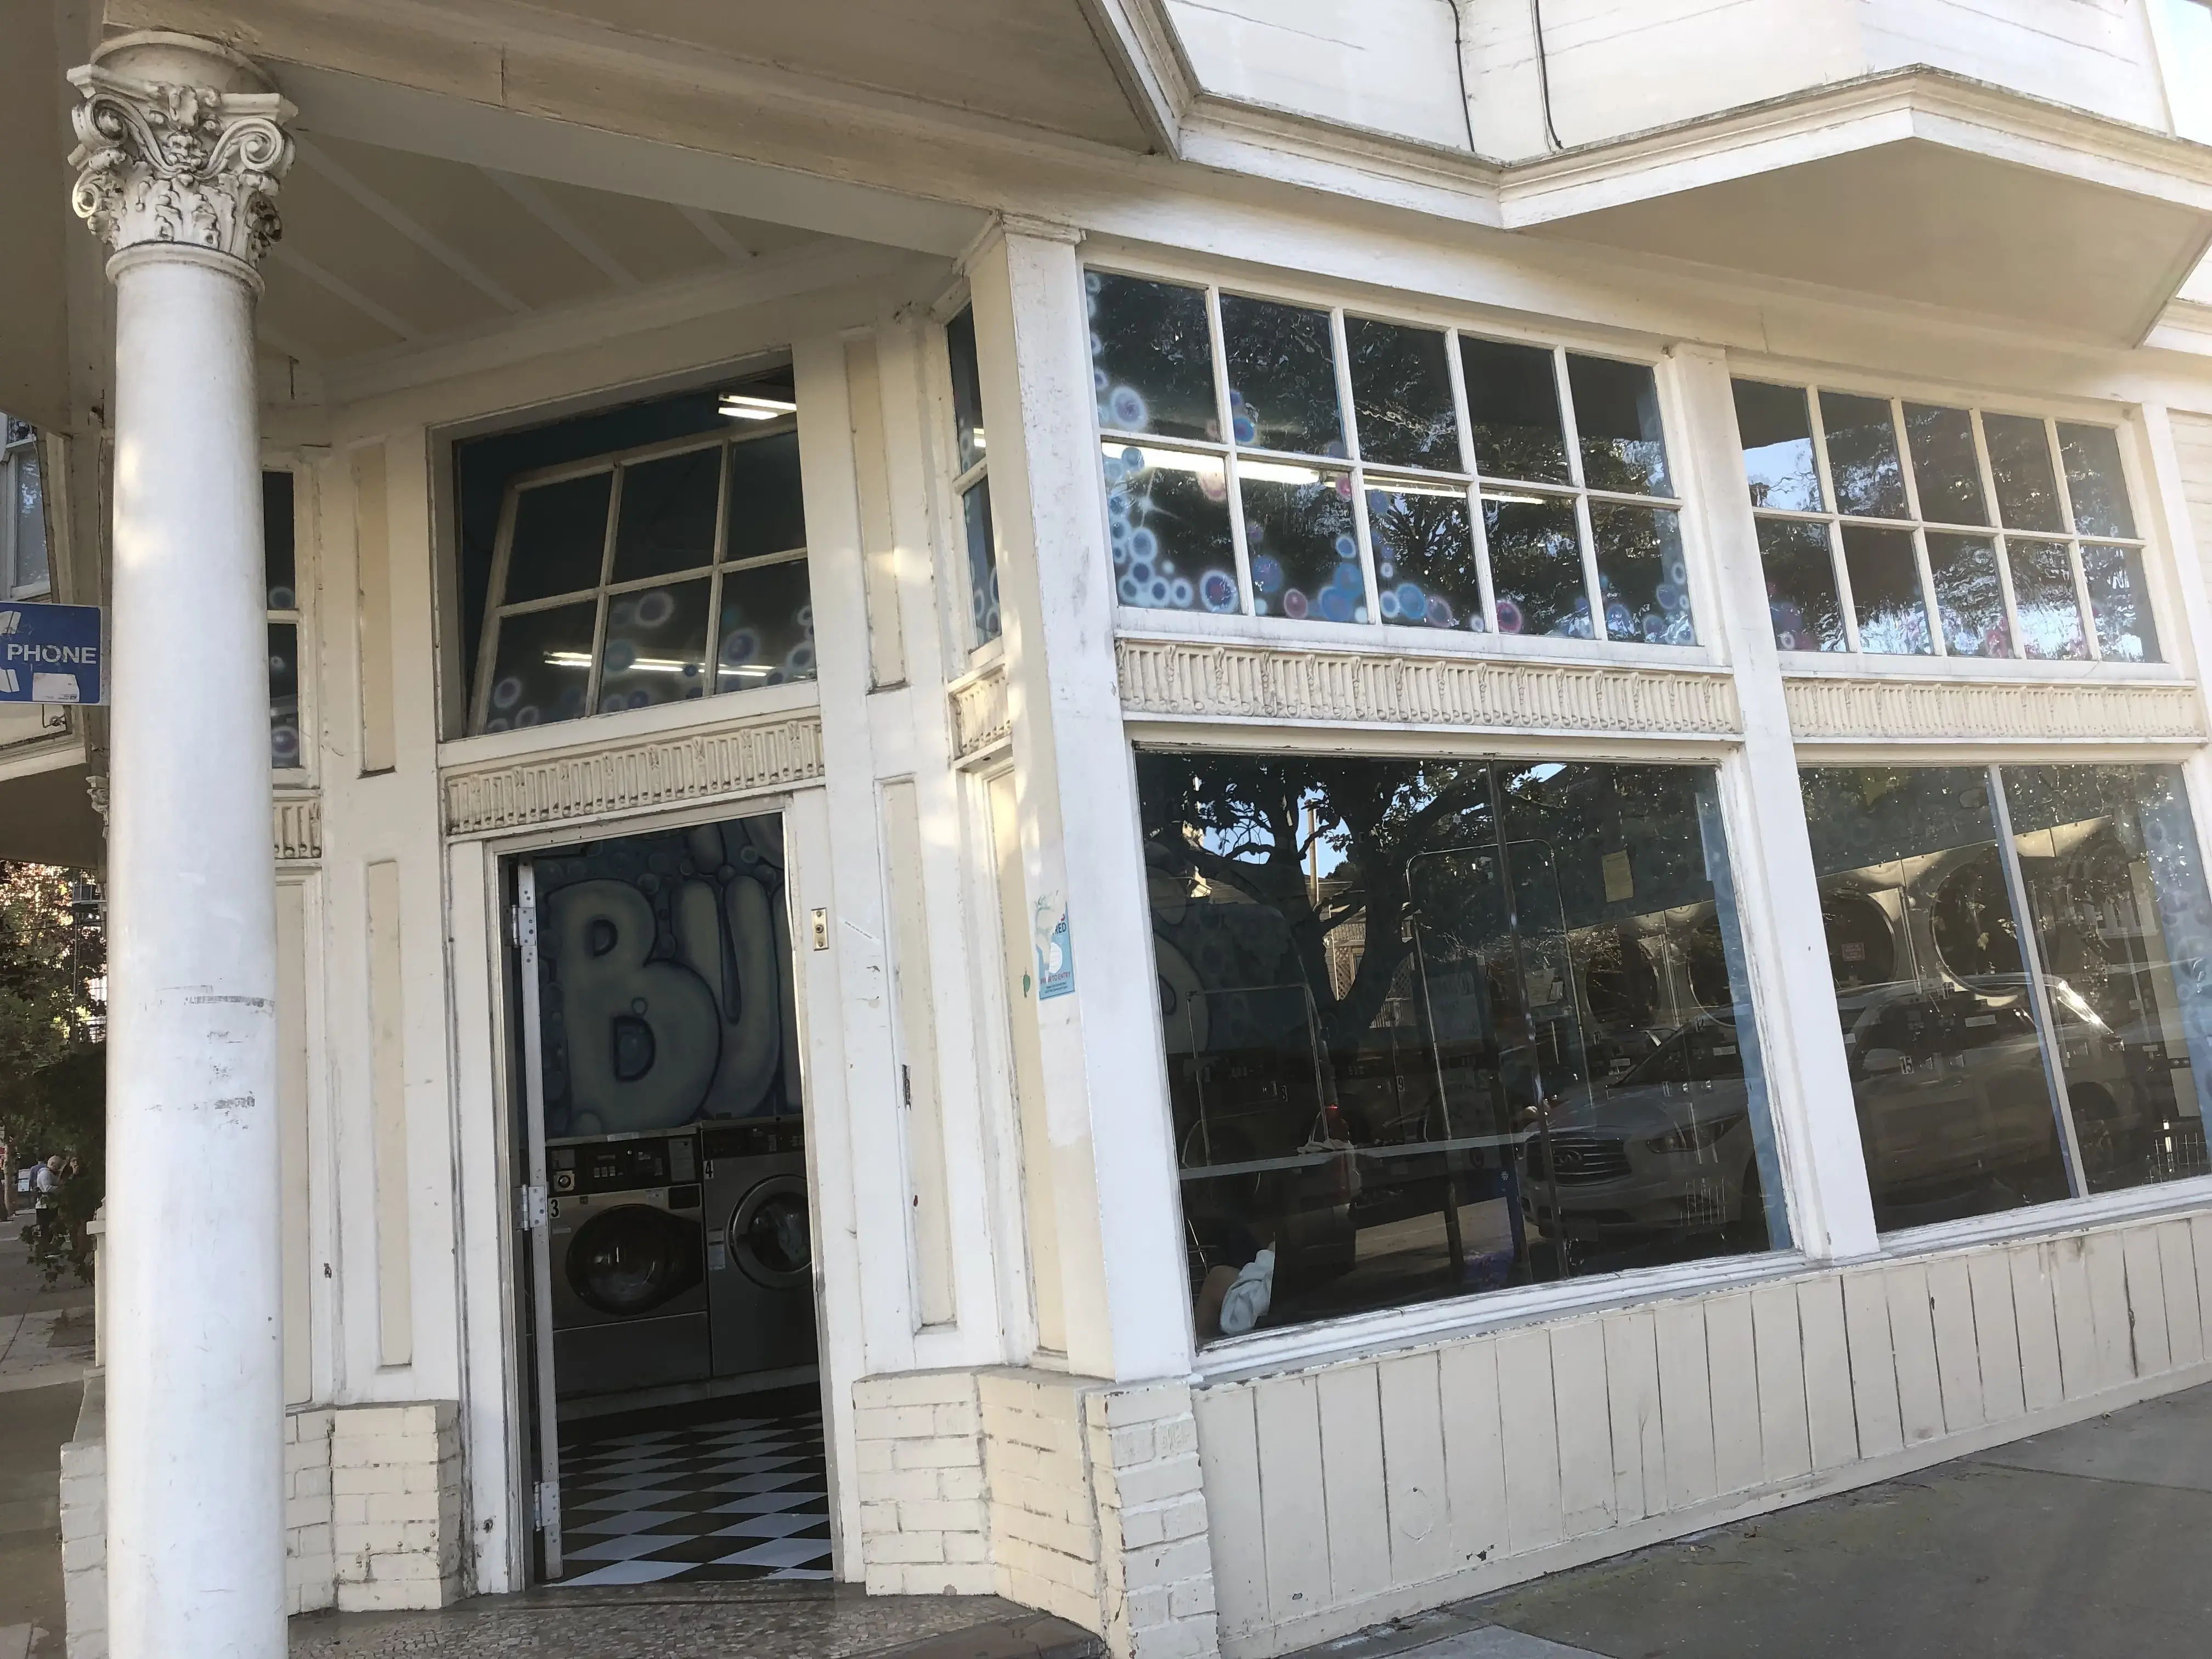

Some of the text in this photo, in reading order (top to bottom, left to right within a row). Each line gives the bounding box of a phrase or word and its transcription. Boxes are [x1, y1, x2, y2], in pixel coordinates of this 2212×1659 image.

[7, 644, 97, 664] PHONE
[1052, 922, 1066, 936] RED
[1058, 971, 1070, 980] ENTRY
[545, 876, 802, 1131] BU
[1398, 1076, 1404, 1091] 9
[705, 1160, 713, 1178] 4
[550, 1199, 559, 1217] 3
